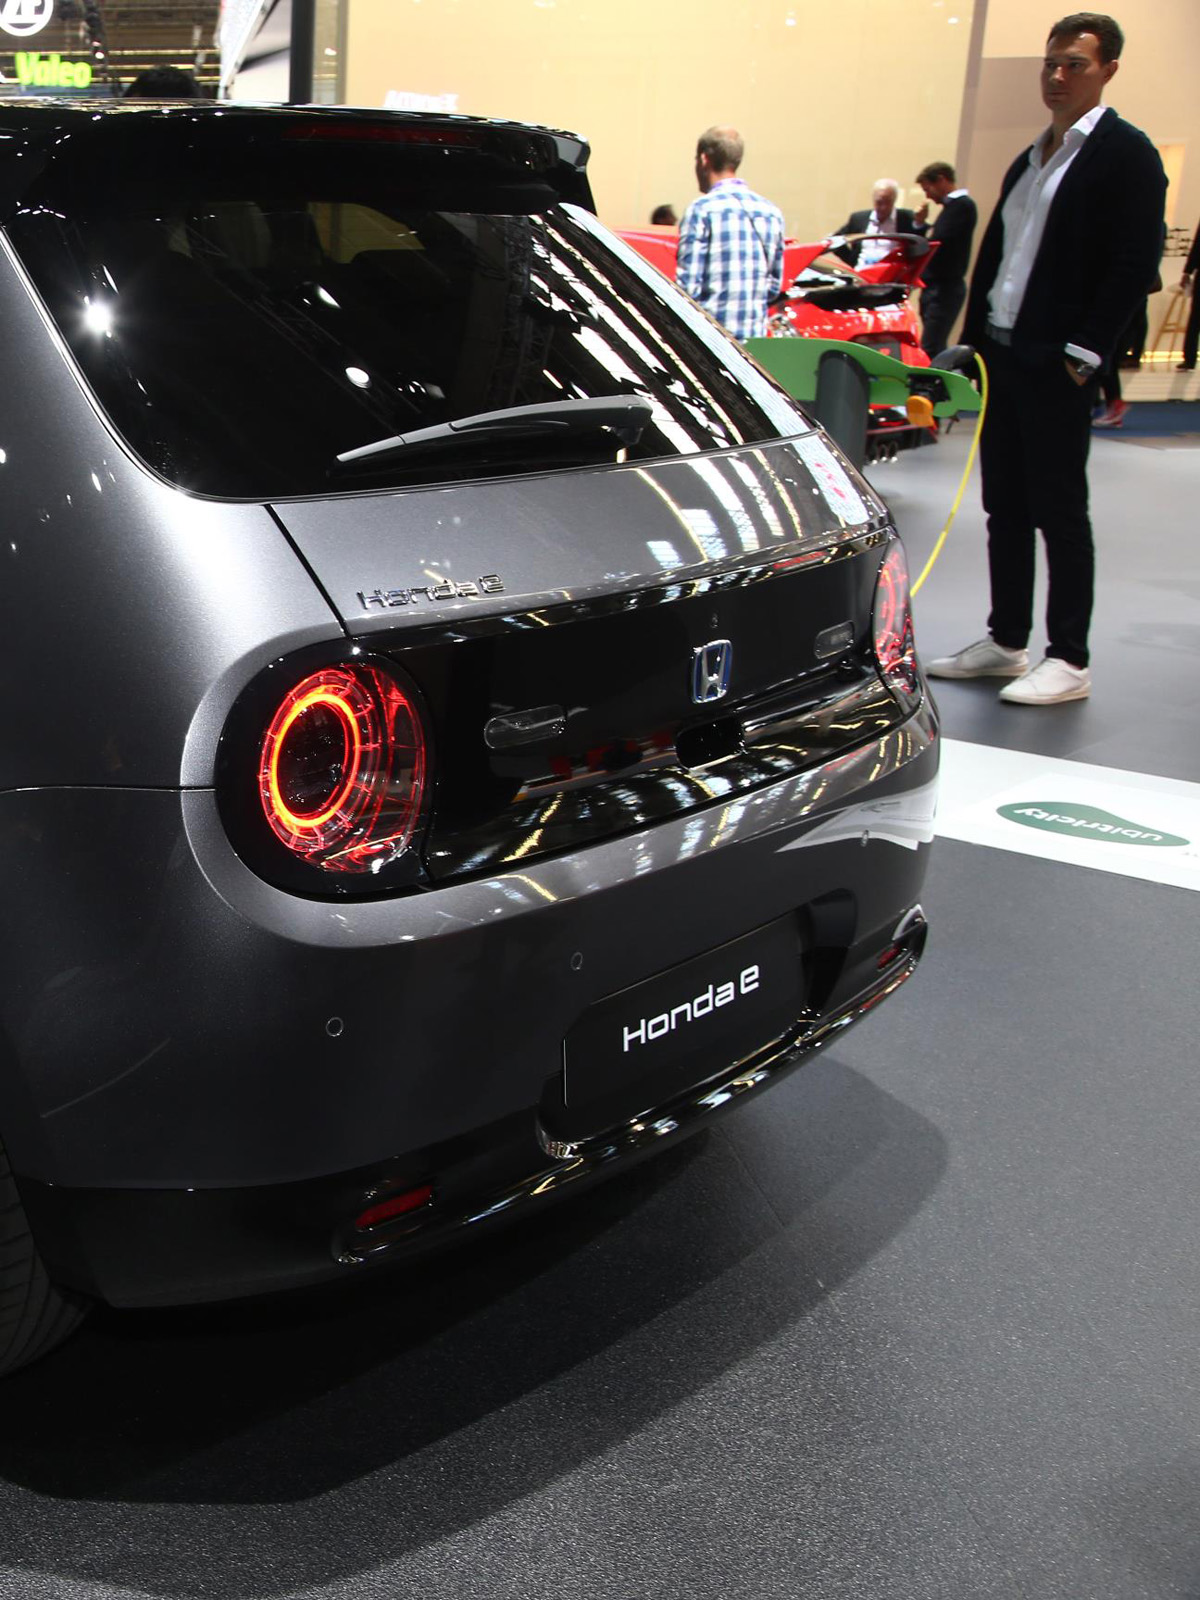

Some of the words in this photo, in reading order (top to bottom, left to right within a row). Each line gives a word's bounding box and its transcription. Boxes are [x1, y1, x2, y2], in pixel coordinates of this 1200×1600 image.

[15, 52, 92, 88] Valeo
[357, 578, 480, 610] Honda
[478, 574, 506, 593] e
[1012, 807, 1164, 842] ubitricity
[622, 981, 735, 1052] Honda
[740, 964, 760, 995] e
